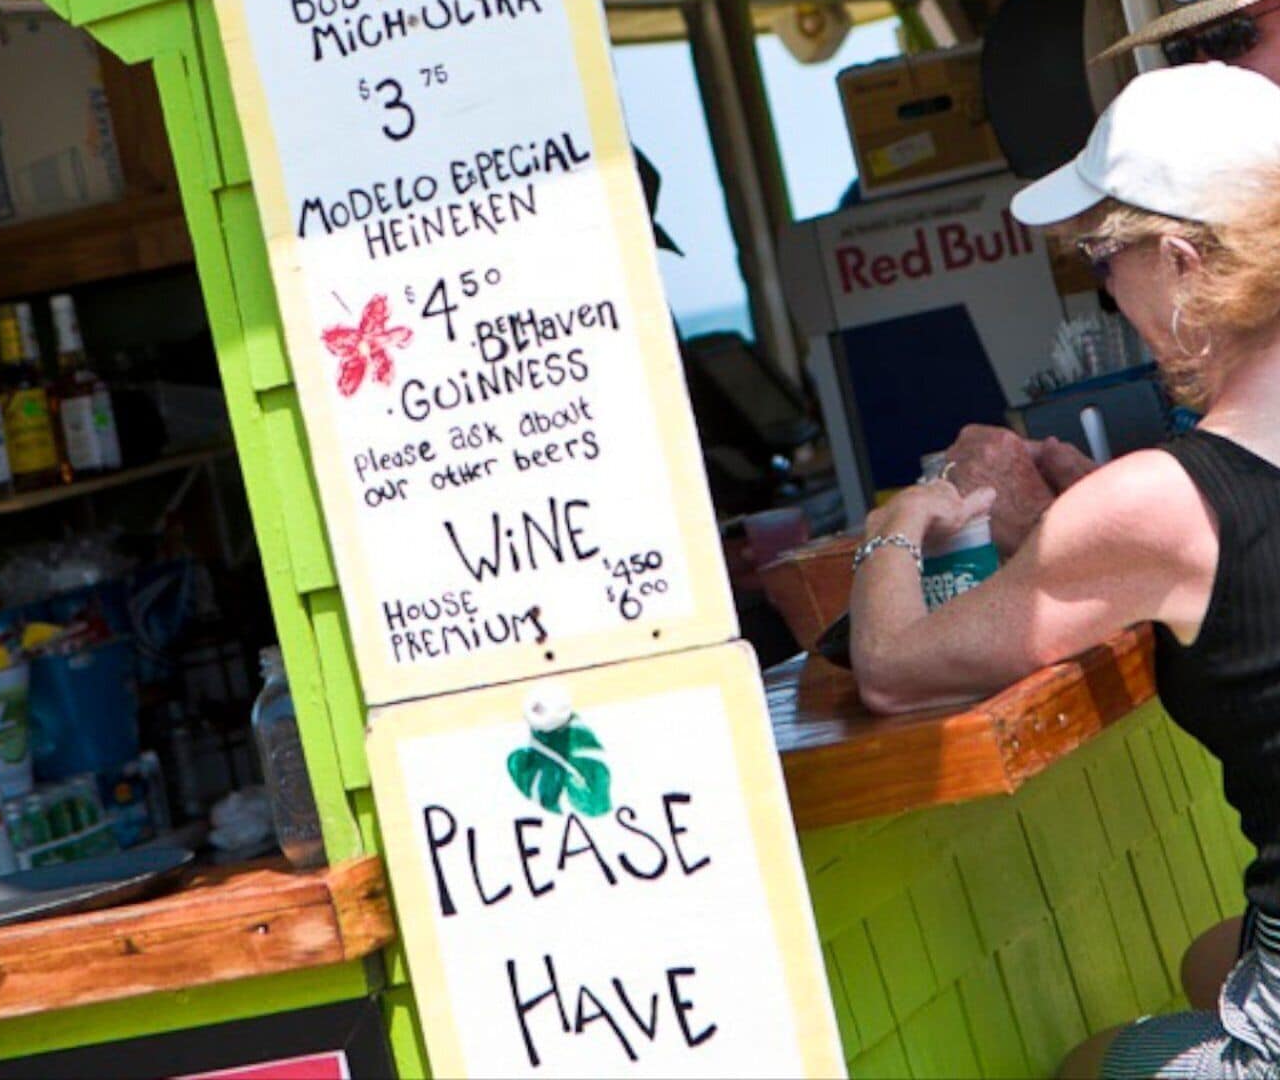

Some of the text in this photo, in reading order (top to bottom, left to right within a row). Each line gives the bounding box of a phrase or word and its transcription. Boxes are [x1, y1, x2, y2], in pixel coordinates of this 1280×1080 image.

[297, 176, 438, 239] MODELO
[835, 223, 932, 293] Red
[938, 207, 1034, 270] Bull
[450, 414, 503, 449] ask
[519, 396, 595, 437] about
[364, 477, 408, 508] our
[513, 429, 600, 474] beers
[423, 792, 710, 917] PLEASE
[506, 954, 718, 1068] HAVE
